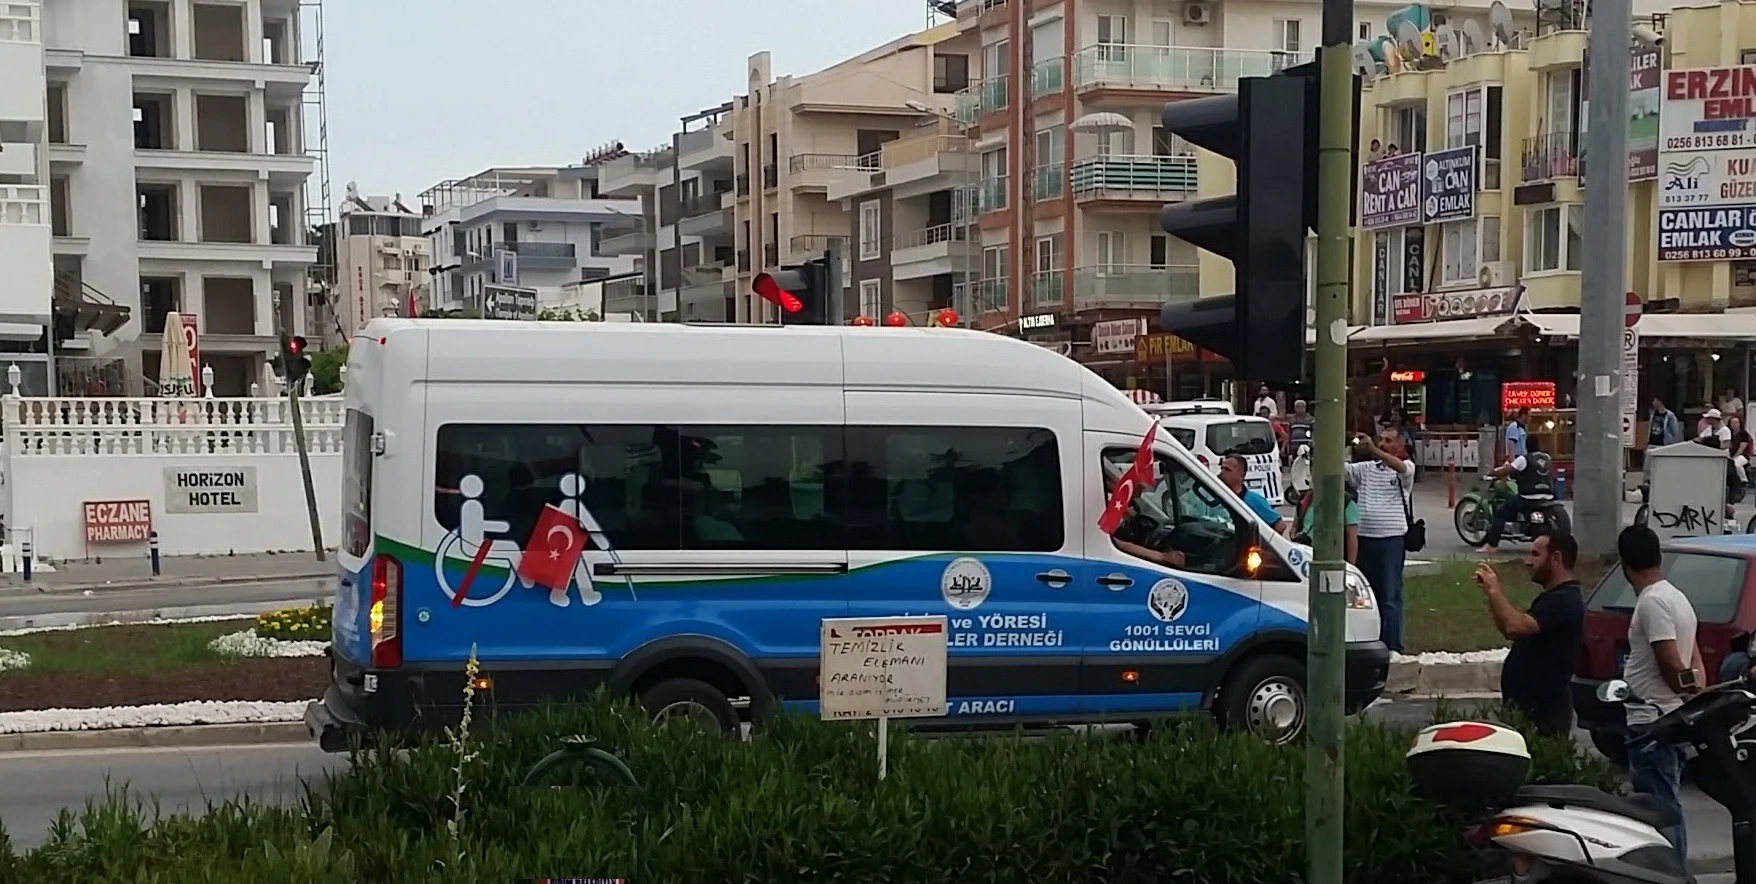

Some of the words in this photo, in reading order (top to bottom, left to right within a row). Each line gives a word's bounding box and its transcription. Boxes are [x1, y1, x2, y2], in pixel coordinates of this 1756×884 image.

[1667, 137, 1691, 149] 0256
[1695, 136, 1713, 148] 813
[1716, 135, 1729, 147] 68
[1731, 134, 1743, 146] 81
[1379, 169, 1400, 194] CAN
[1445, 169, 1468, 190] CAN
[1665, 176, 1698, 190] Ali
[1364, 191, 1386, 215] RENT
[1387, 193, 1396, 212] A
[1397, 182, 1417, 209] CAR
[1440, 194, 1470, 212] EMLAK
[1665, 195, 1682, 203] 813
[1661, 209, 1742, 230] CANLAR
[1661, 230, 1722, 248] EMLAK
[1665, 250, 1690, 260] 0256
[1692, 249, 1711, 259] 813
[1713, 248, 1726, 258] 60
[1728, 248, 1742, 258] 99
[1408, 244, 1420, 293] CANL
[189, 492, 241, 506] HOTEL
[85, 502, 150, 524] ECZANE
[1653, 505, 1717, 534] DARK
[87, 524, 149, 541] PHARMACY
[952, 617, 973, 629] ve
[979, 612, 1046, 629] YÖRESİ
[1124, 625, 1159, 636] 1001
[1165, 622, 1210, 636] SEVGİ
[984, 630, 1063, 647] DERNEĞİ
[1109, 637, 1220, 651] GÖNÜLLÜLERİ
[958, 699, 1015, 715] ARACI
